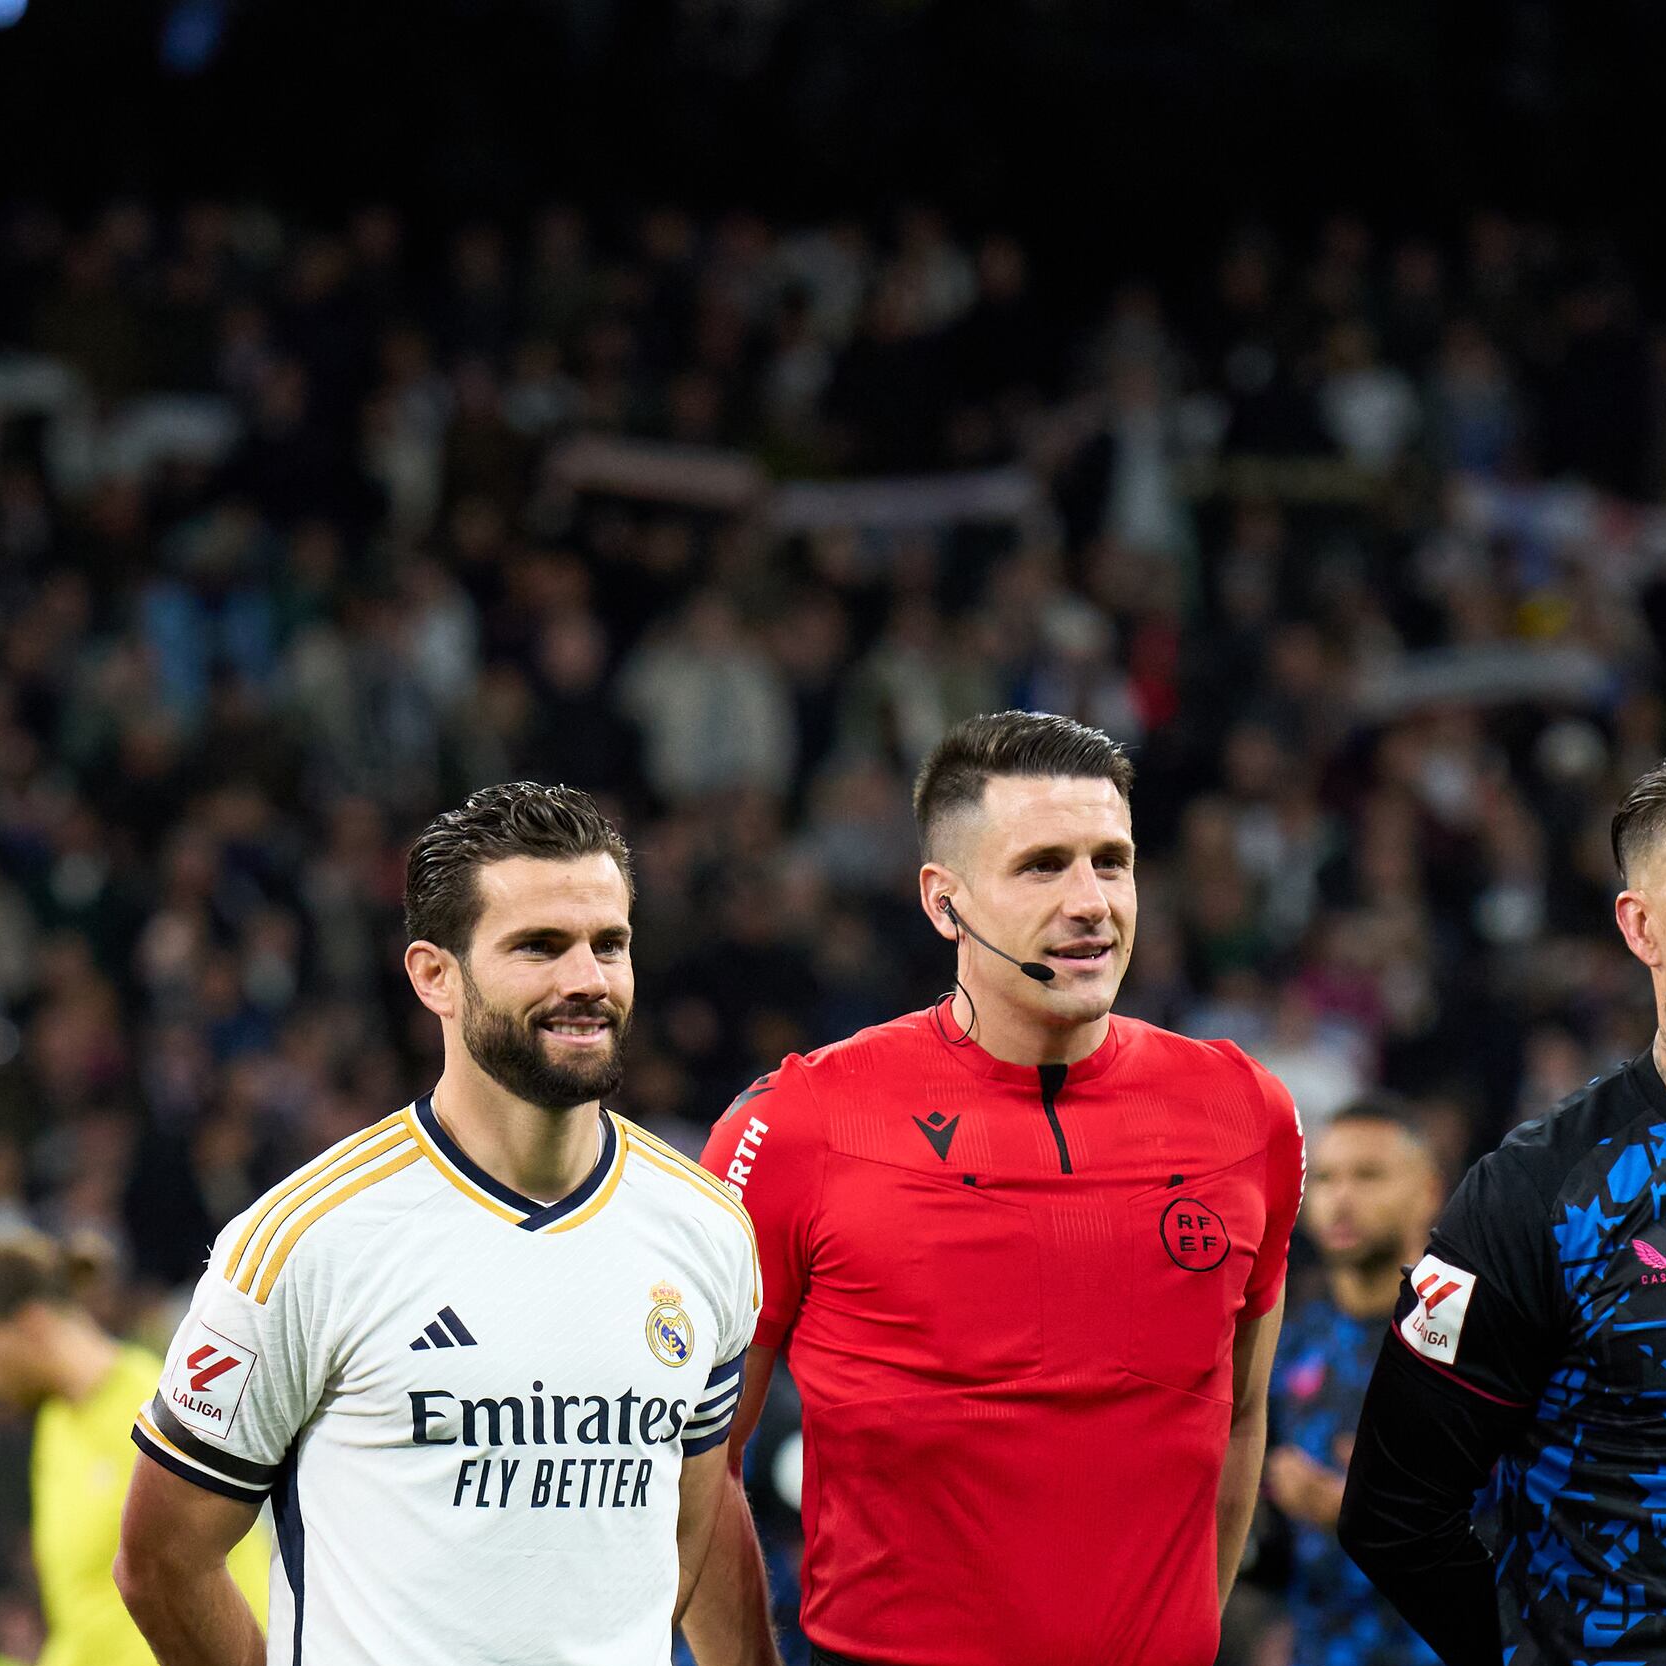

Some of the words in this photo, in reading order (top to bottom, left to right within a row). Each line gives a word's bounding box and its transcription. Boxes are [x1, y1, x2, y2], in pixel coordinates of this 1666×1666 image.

[1412, 1316, 1448, 1348] LAIGA
[173, 1387, 222, 1421] LALIGA
[407, 1380, 687, 1447] Emirates
[453, 1459, 520, 1508] FLY
[531, 1459, 653, 1508] BETTER
